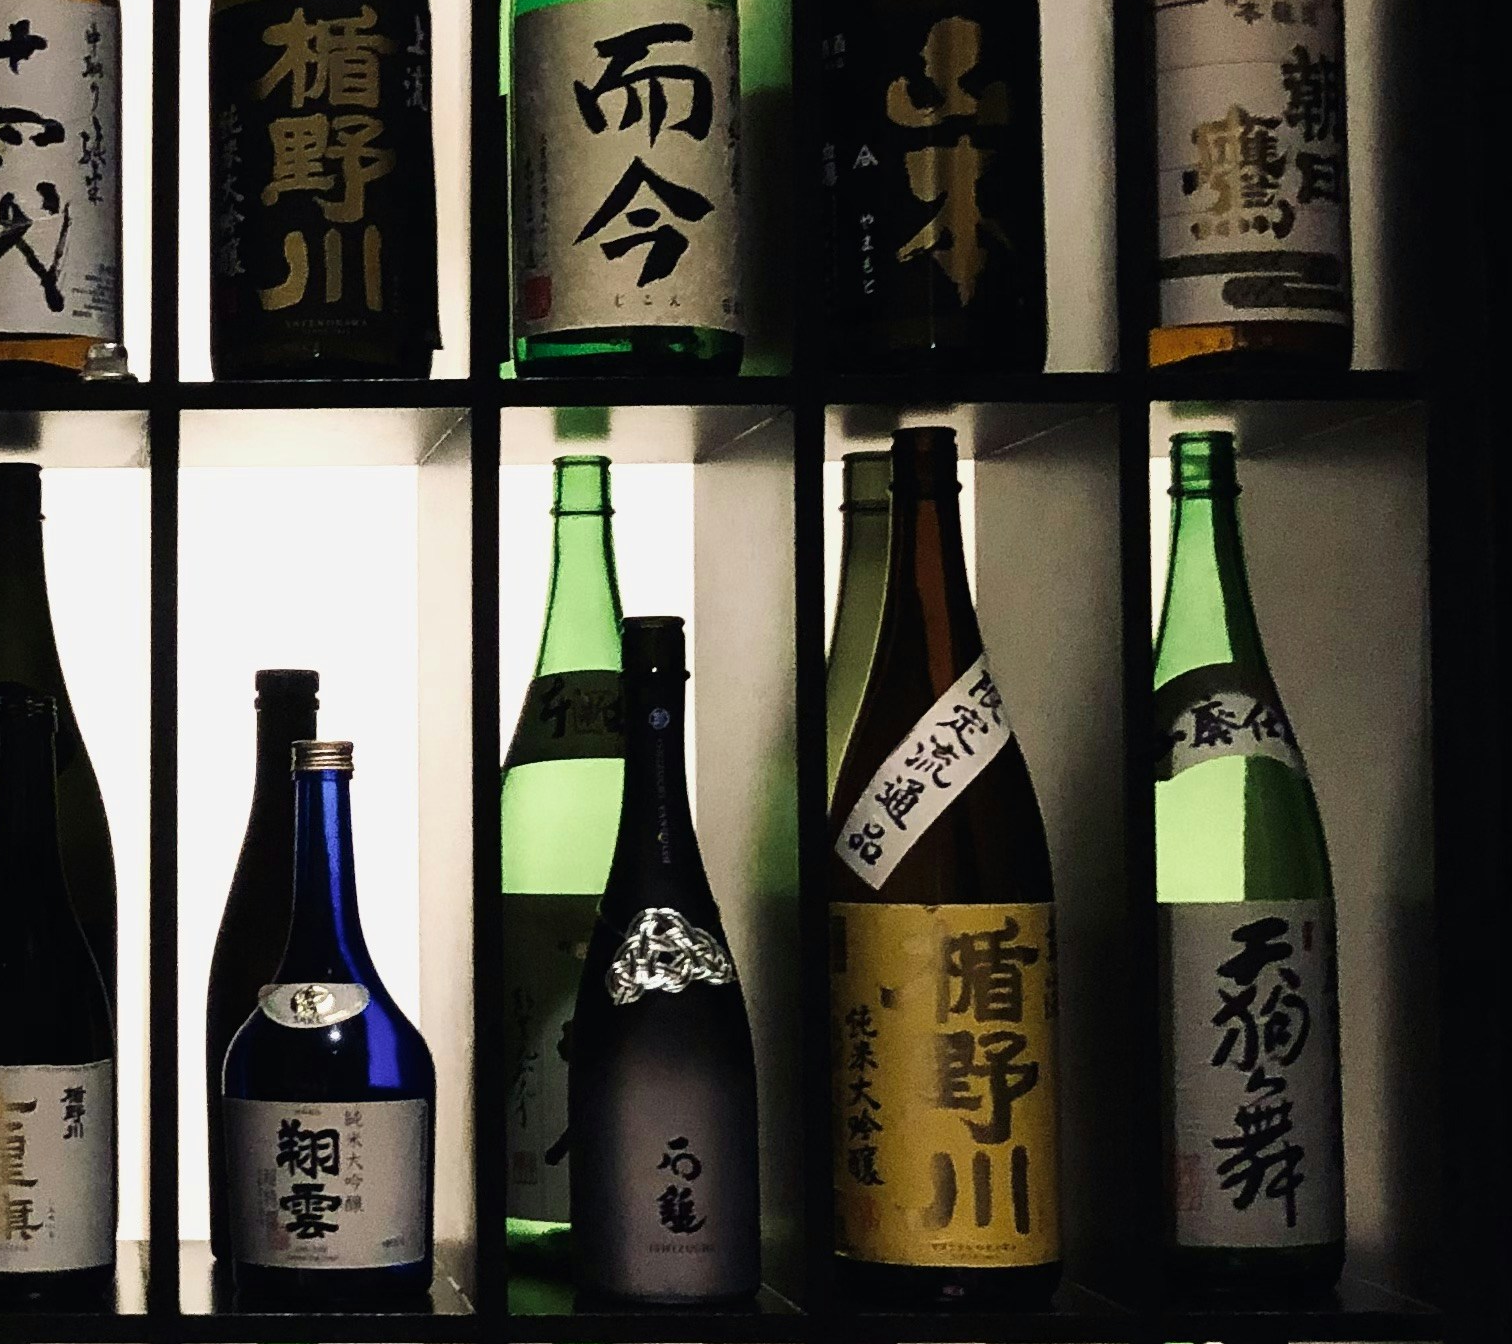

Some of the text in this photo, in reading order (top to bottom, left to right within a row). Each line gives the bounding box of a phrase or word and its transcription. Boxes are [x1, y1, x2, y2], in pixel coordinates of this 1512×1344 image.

[251, 5, 397, 312] 楯野川
[573, 23, 715, 287] 而今
[886, 16, 1018, 308] 山本
[849, 668, 1004, 866] 限定流通品
[276, 1118, 342, 1239] 翔雲
